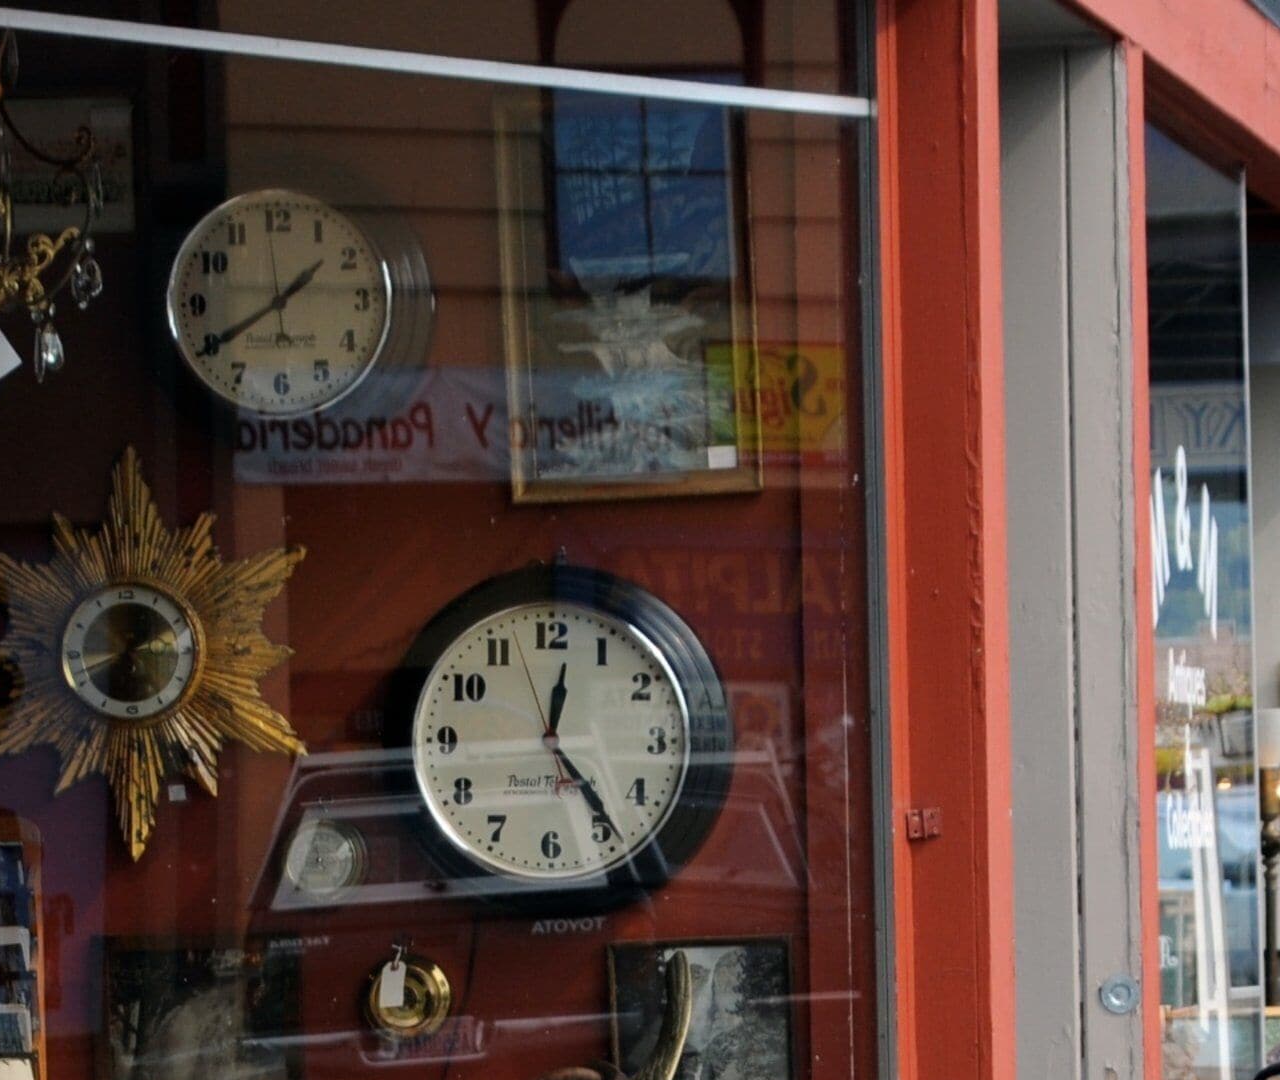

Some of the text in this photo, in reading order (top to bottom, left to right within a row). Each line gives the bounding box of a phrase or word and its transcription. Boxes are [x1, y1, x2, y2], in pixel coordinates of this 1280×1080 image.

[228, 222, 246, 246] 11
[265, 209, 291, 233] 12
[314, 219, 323, 243] 1
[201, 251, 228, 274] 10
[340, 248, 357, 270] 2
[190, 293, 206, 317] 9
[354, 288, 370, 312] 3
[339, 329, 356, 353] 4
[231, 362, 247, 384] 7
[313, 359, 330, 382] 5
[273, 373, 290, 396] 6
[535, 621, 568, 650] 12
[486, 638, 510, 666] 11
[596, 638, 608, 666] 1
[452, 673, 486, 702] 10
[631, 672, 652, 701] 2
[437, 726, 458, 755] 9
[647, 727, 667, 755] 3
[453, 777, 473, 806] 8
[507, 774, 542, 788] Postal
[625, 777, 649, 806] 4
[487, 815, 507, 843] 7
[591, 815, 612, 843] 5
[541, 831, 562, 859] 6
